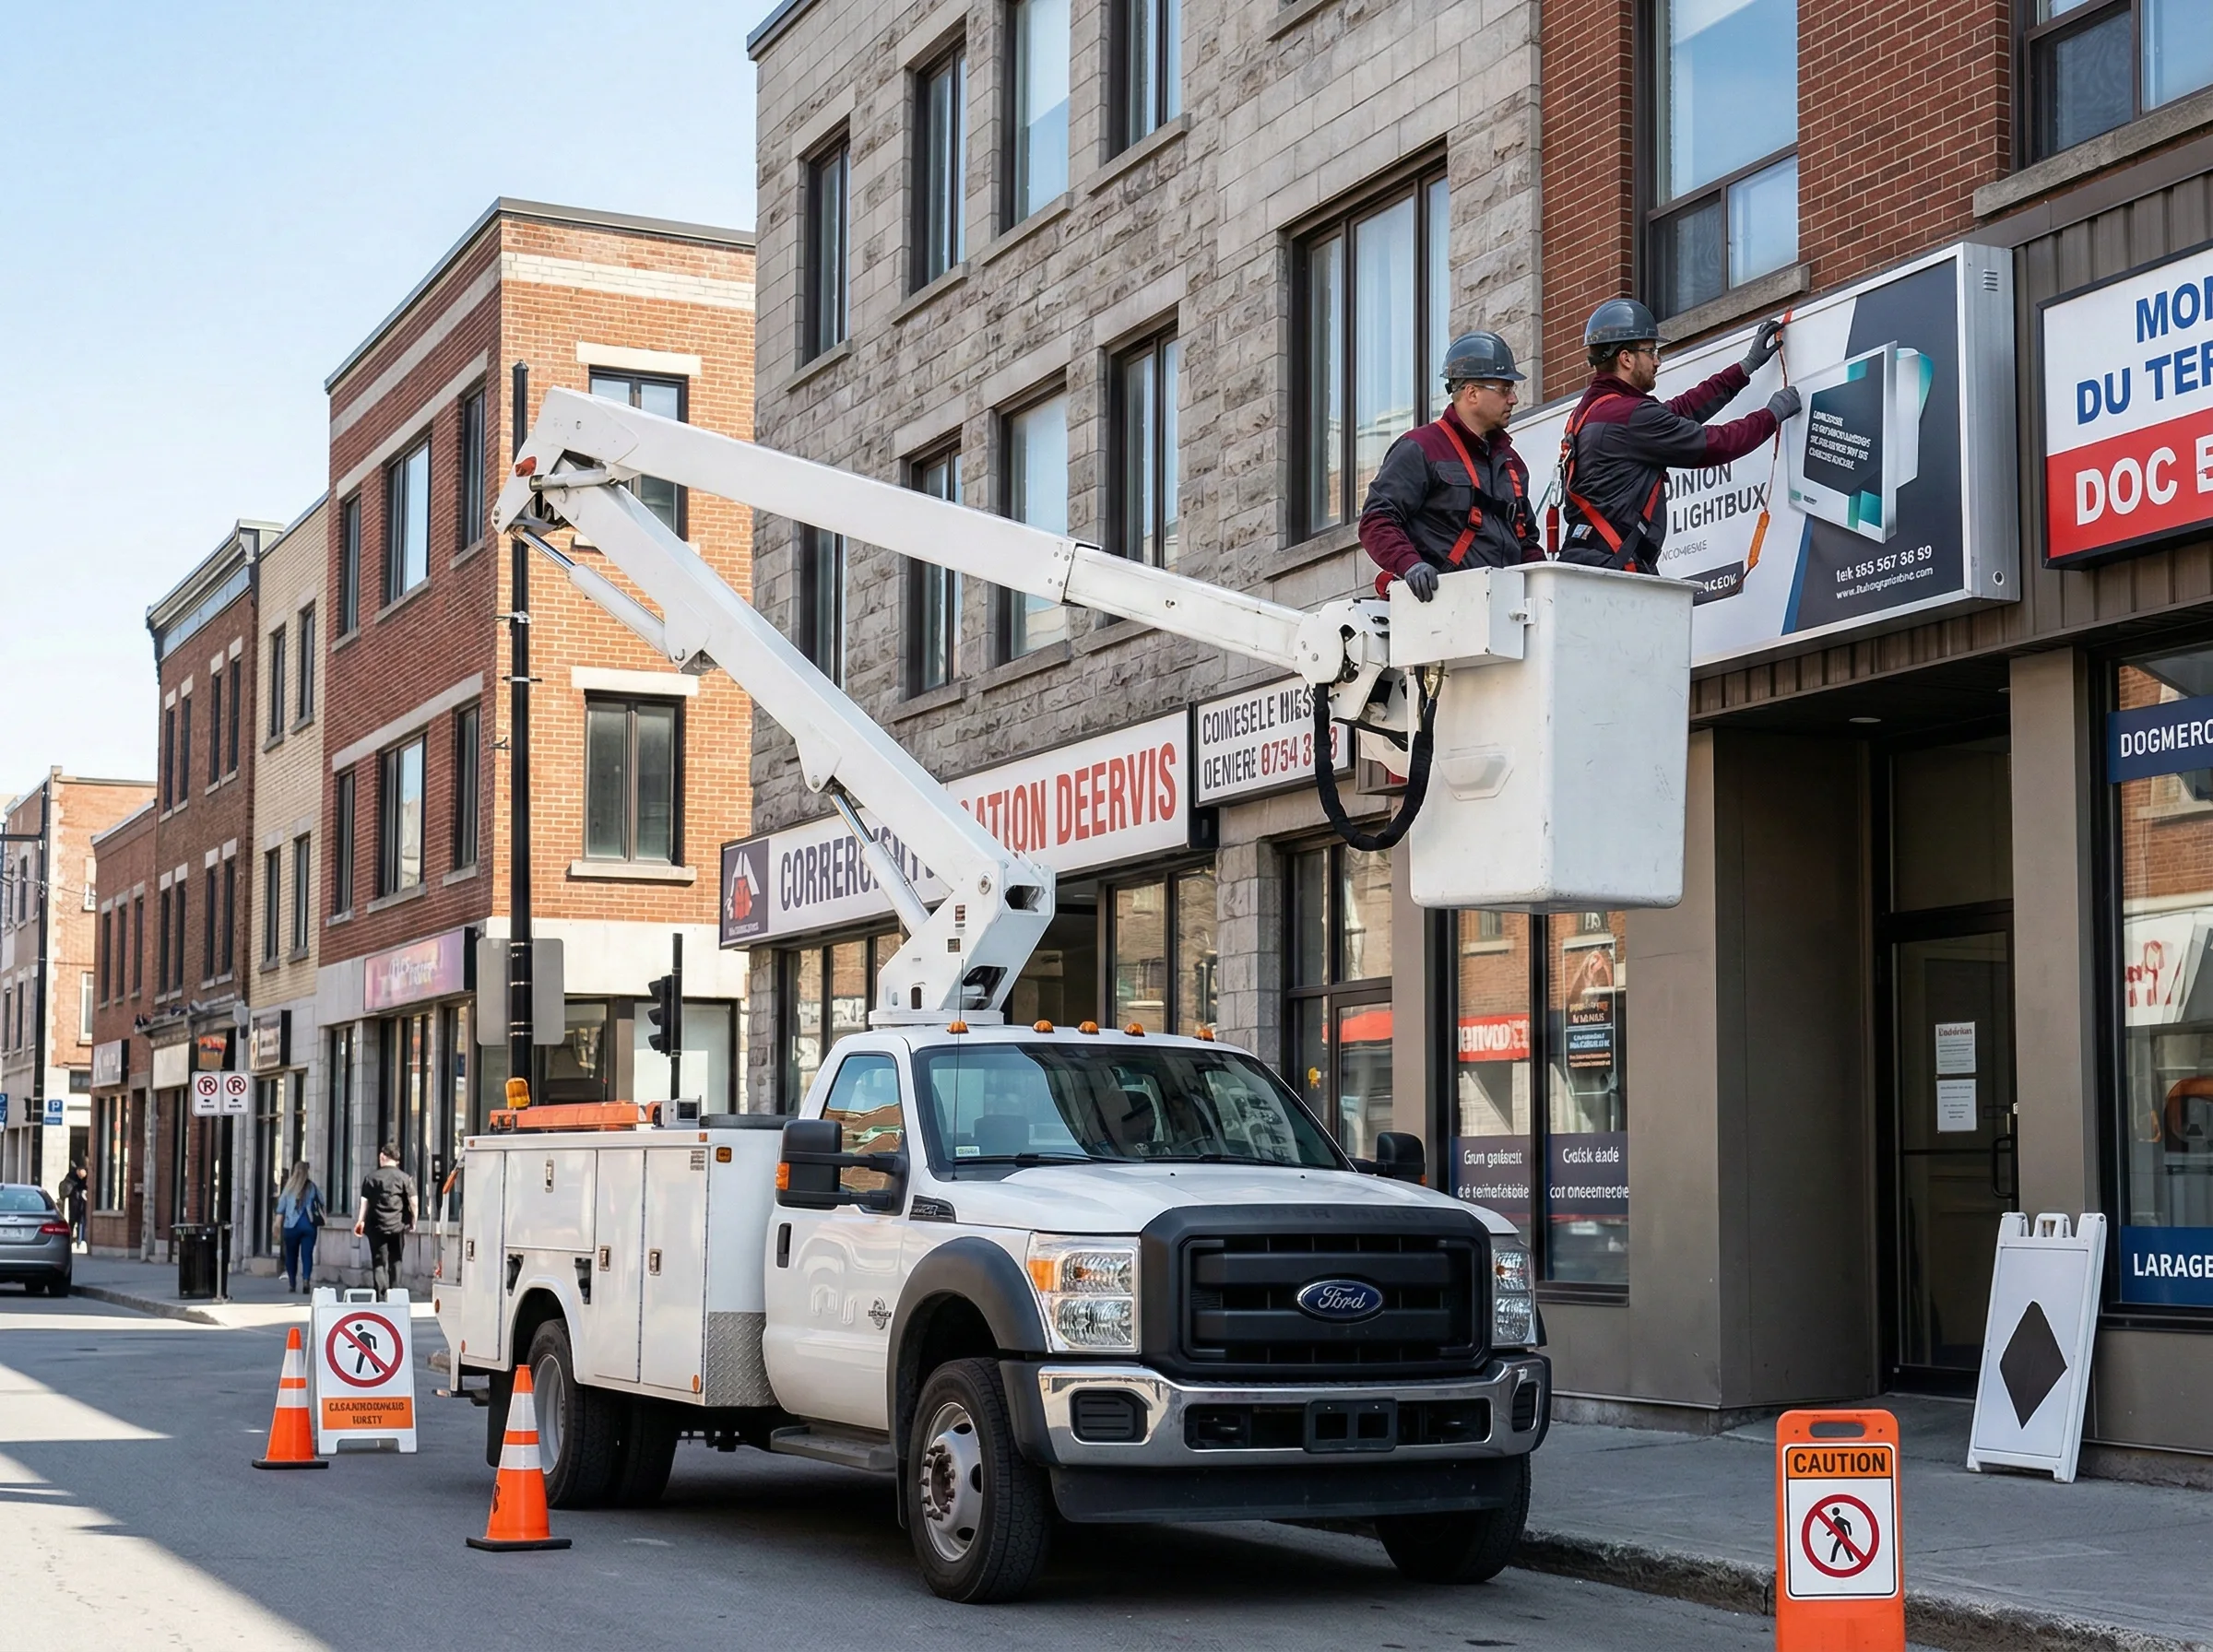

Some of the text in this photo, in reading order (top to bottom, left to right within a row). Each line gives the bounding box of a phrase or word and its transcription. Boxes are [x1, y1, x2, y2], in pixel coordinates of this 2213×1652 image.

[2077, 367, 2131, 425] DU
[2076, 446, 2178, 526] DOC
[1673, 482, 1767, 535] LIGHTBUX
[1876, 554, 1897, 572] 567
[1056, 742, 1177, 846] DEERVIS
[2133, 1253, 2213, 1279] LARAGE
[1318, 1286, 1367, 1309] Ford
[1793, 1452, 1886, 1473] CAUTION
